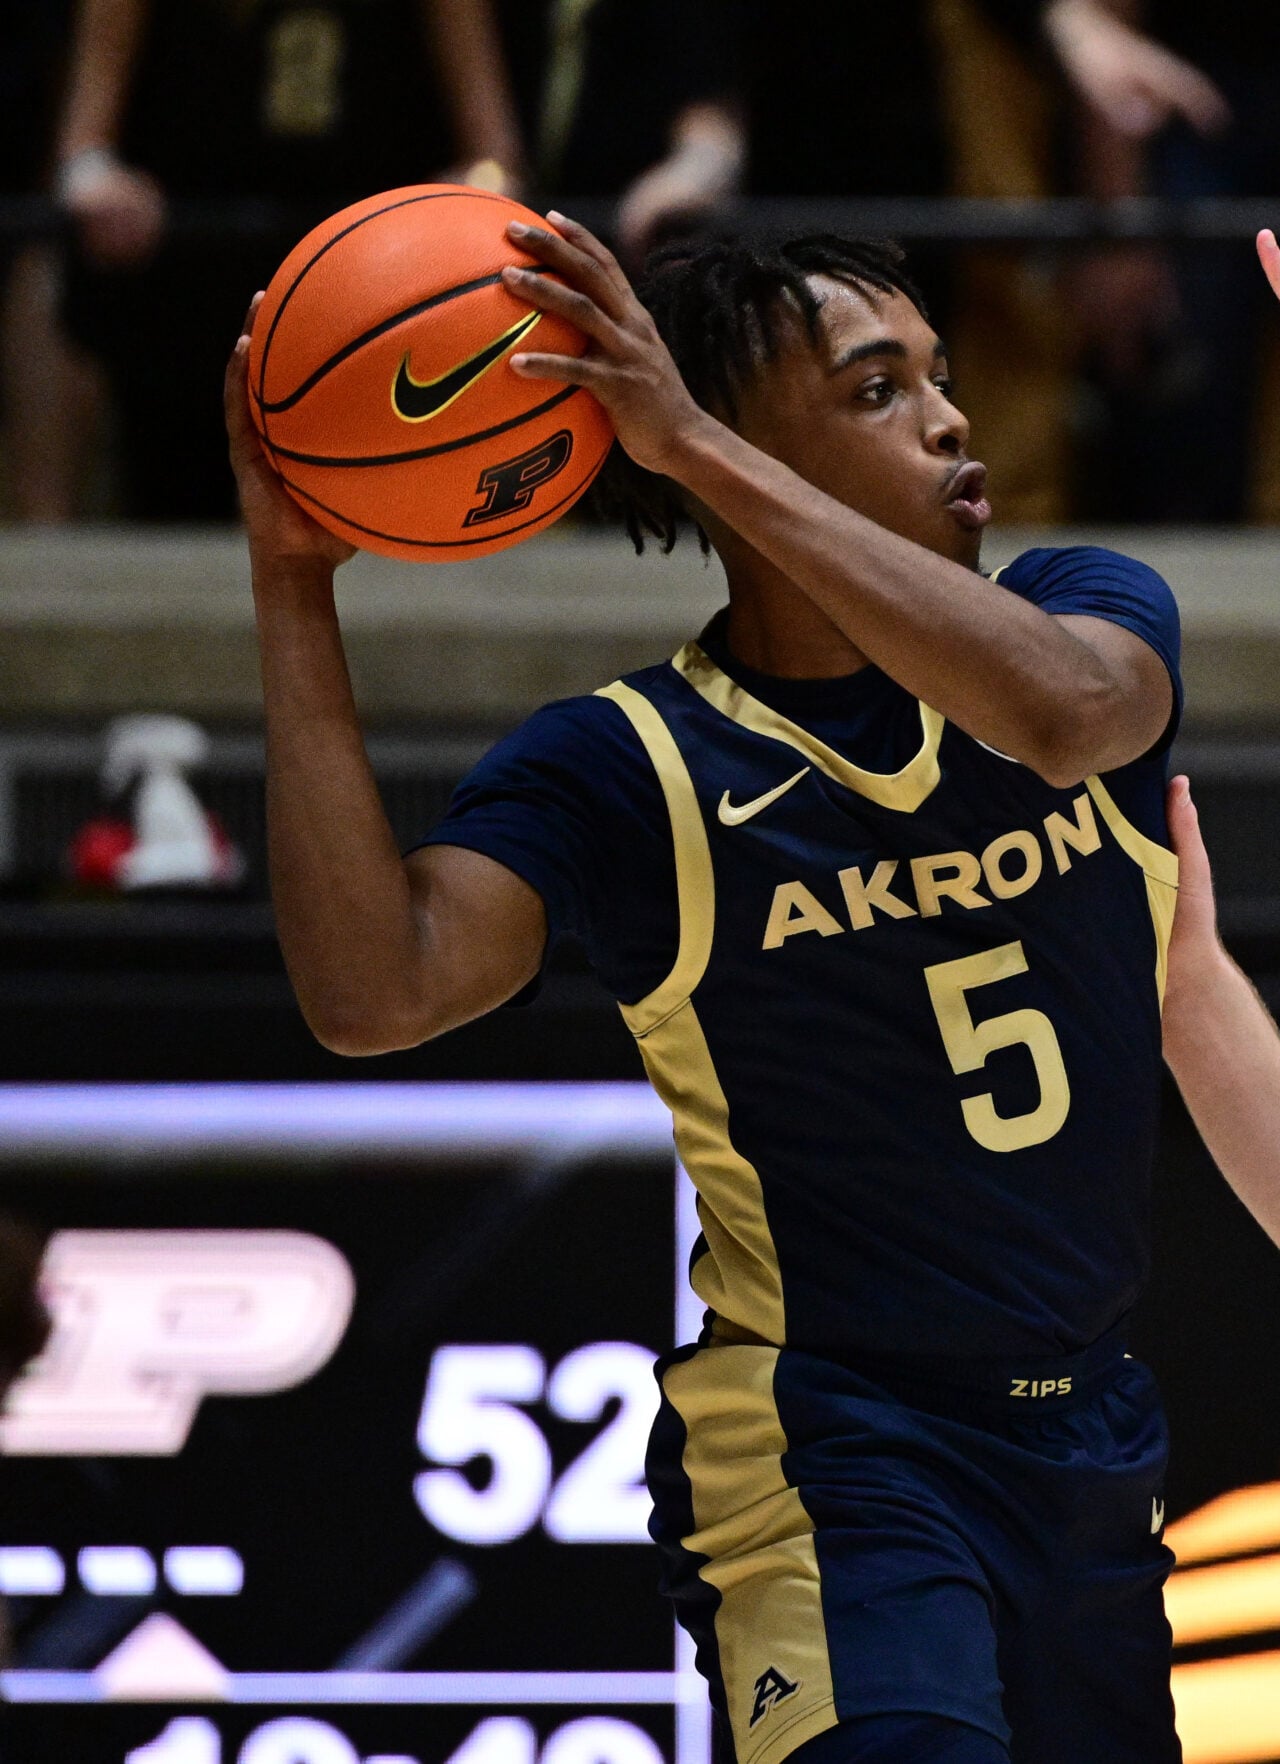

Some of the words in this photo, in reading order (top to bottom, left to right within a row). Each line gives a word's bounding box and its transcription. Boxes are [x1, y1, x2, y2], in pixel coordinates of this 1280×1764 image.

[462, 429, 573, 528] P
[762, 793, 1102, 950] AKRON
[923, 939, 1071, 1153] 5
[412, 1341, 661, 1544] 52
[1009, 1377, 1072, 1398] ZIPS
[749, 1665, 800, 1730] A
